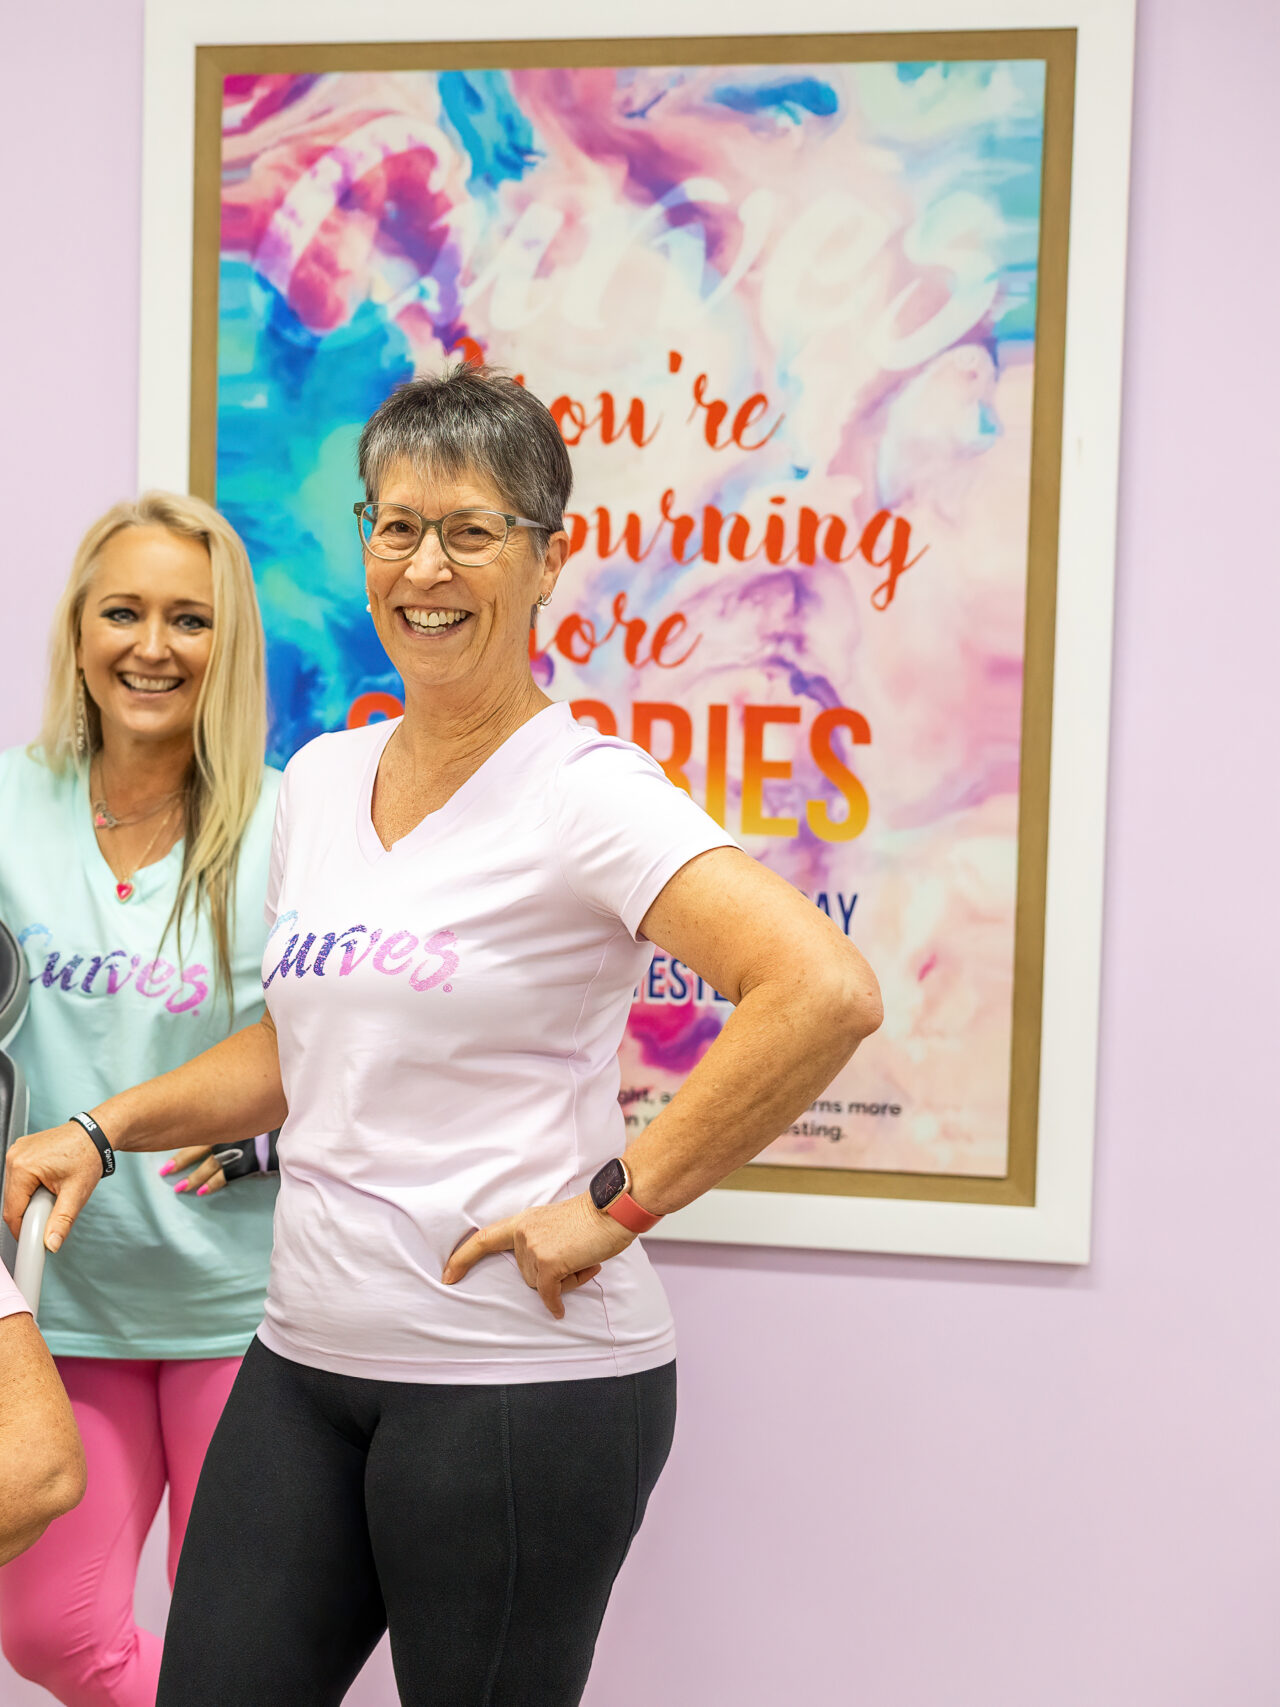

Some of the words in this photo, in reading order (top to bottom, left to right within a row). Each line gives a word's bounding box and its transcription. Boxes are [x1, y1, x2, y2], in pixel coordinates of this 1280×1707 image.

[453, 336, 786, 451] ou're
[528, 590, 703, 669] ore
[848, 1102, 902, 1117] more
